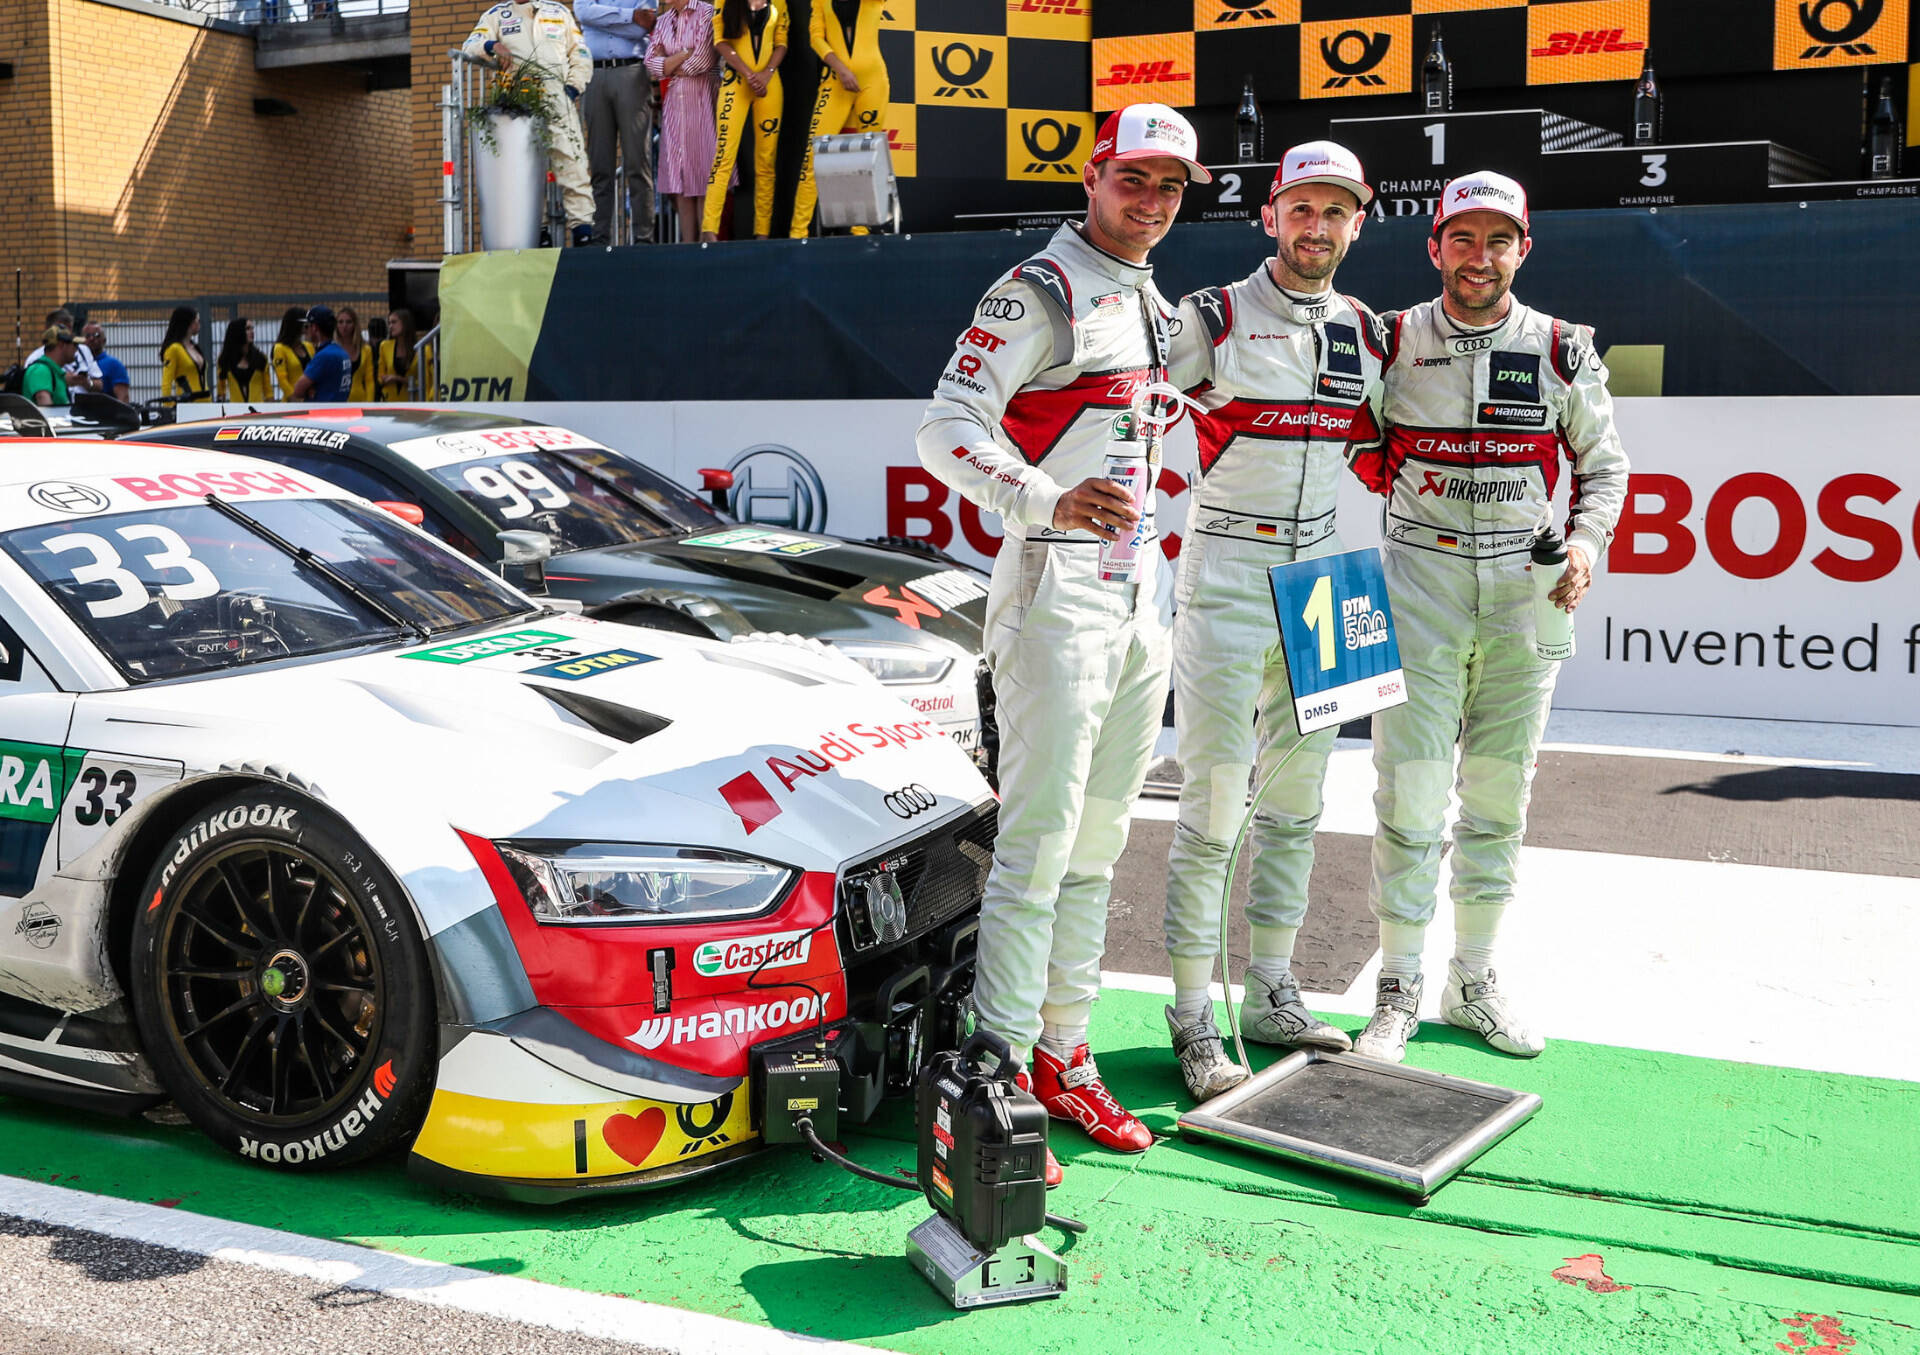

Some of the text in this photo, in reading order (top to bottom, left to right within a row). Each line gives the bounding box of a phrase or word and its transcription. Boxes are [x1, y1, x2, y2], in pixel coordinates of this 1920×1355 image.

[1539, 29, 1635, 57] DHL
[1103, 61, 1183, 85] DHL
[814, 87, 832, 116] Post
[708, 91, 735, 184] Deutsche Post
[1158, 119, 1184, 135] Castrol
[1424, 123, 1446, 165] 1
[1639, 154, 1668, 187] 3
[1218, 173, 1242, 203] 2
[1857, 186, 1918, 196] CHAMPAGNE
[1619, 195, 1675, 205] CHAMPAGNE
[1017, 217, 1062, 226] CHAMPAGNE
[1202, 210, 1250, 220] CHAMPAGNE
[958, 326, 1007, 353] ABT
[1332, 342, 1357, 355] DTM
[956, 376, 987, 394] MAINZ
[1496, 370, 1533, 384] DTM
[1279, 412, 1318, 425] Audi
[241, 425, 350, 449] ROCKENFELLER
[1437, 440, 1537, 456] Audi Sport
[112, 471, 316, 502] BOSCH
[463, 461, 570, 520] 99
[1284, 528, 1294, 536] R.
[1607, 472, 1920, 582] BOS
[1462, 537, 1526, 551] M. Rockenfeller
[41, 523, 221, 618] 33
[1342, 595, 1371, 617] DTM
[1302, 575, 1337, 672] 1
[1344, 610, 1387, 651] 500
[429, 633, 558, 660] DEKRA
[1359, 629, 1389, 648] RACES
[1605, 616, 1878, 673] Invented
[513, 647, 582, 661] 33
[1545, 648, 1570, 656] Sport
[555, 654, 640, 676] DTM
[1377, 682, 1401, 697] BOSCH
[911, 695, 954, 713] Castrol
[1304, 701, 1339, 720] DMSB
[766, 731, 865, 793] Audi
[75, 766, 137, 827] 33
[725, 934, 804, 969] Castrol
